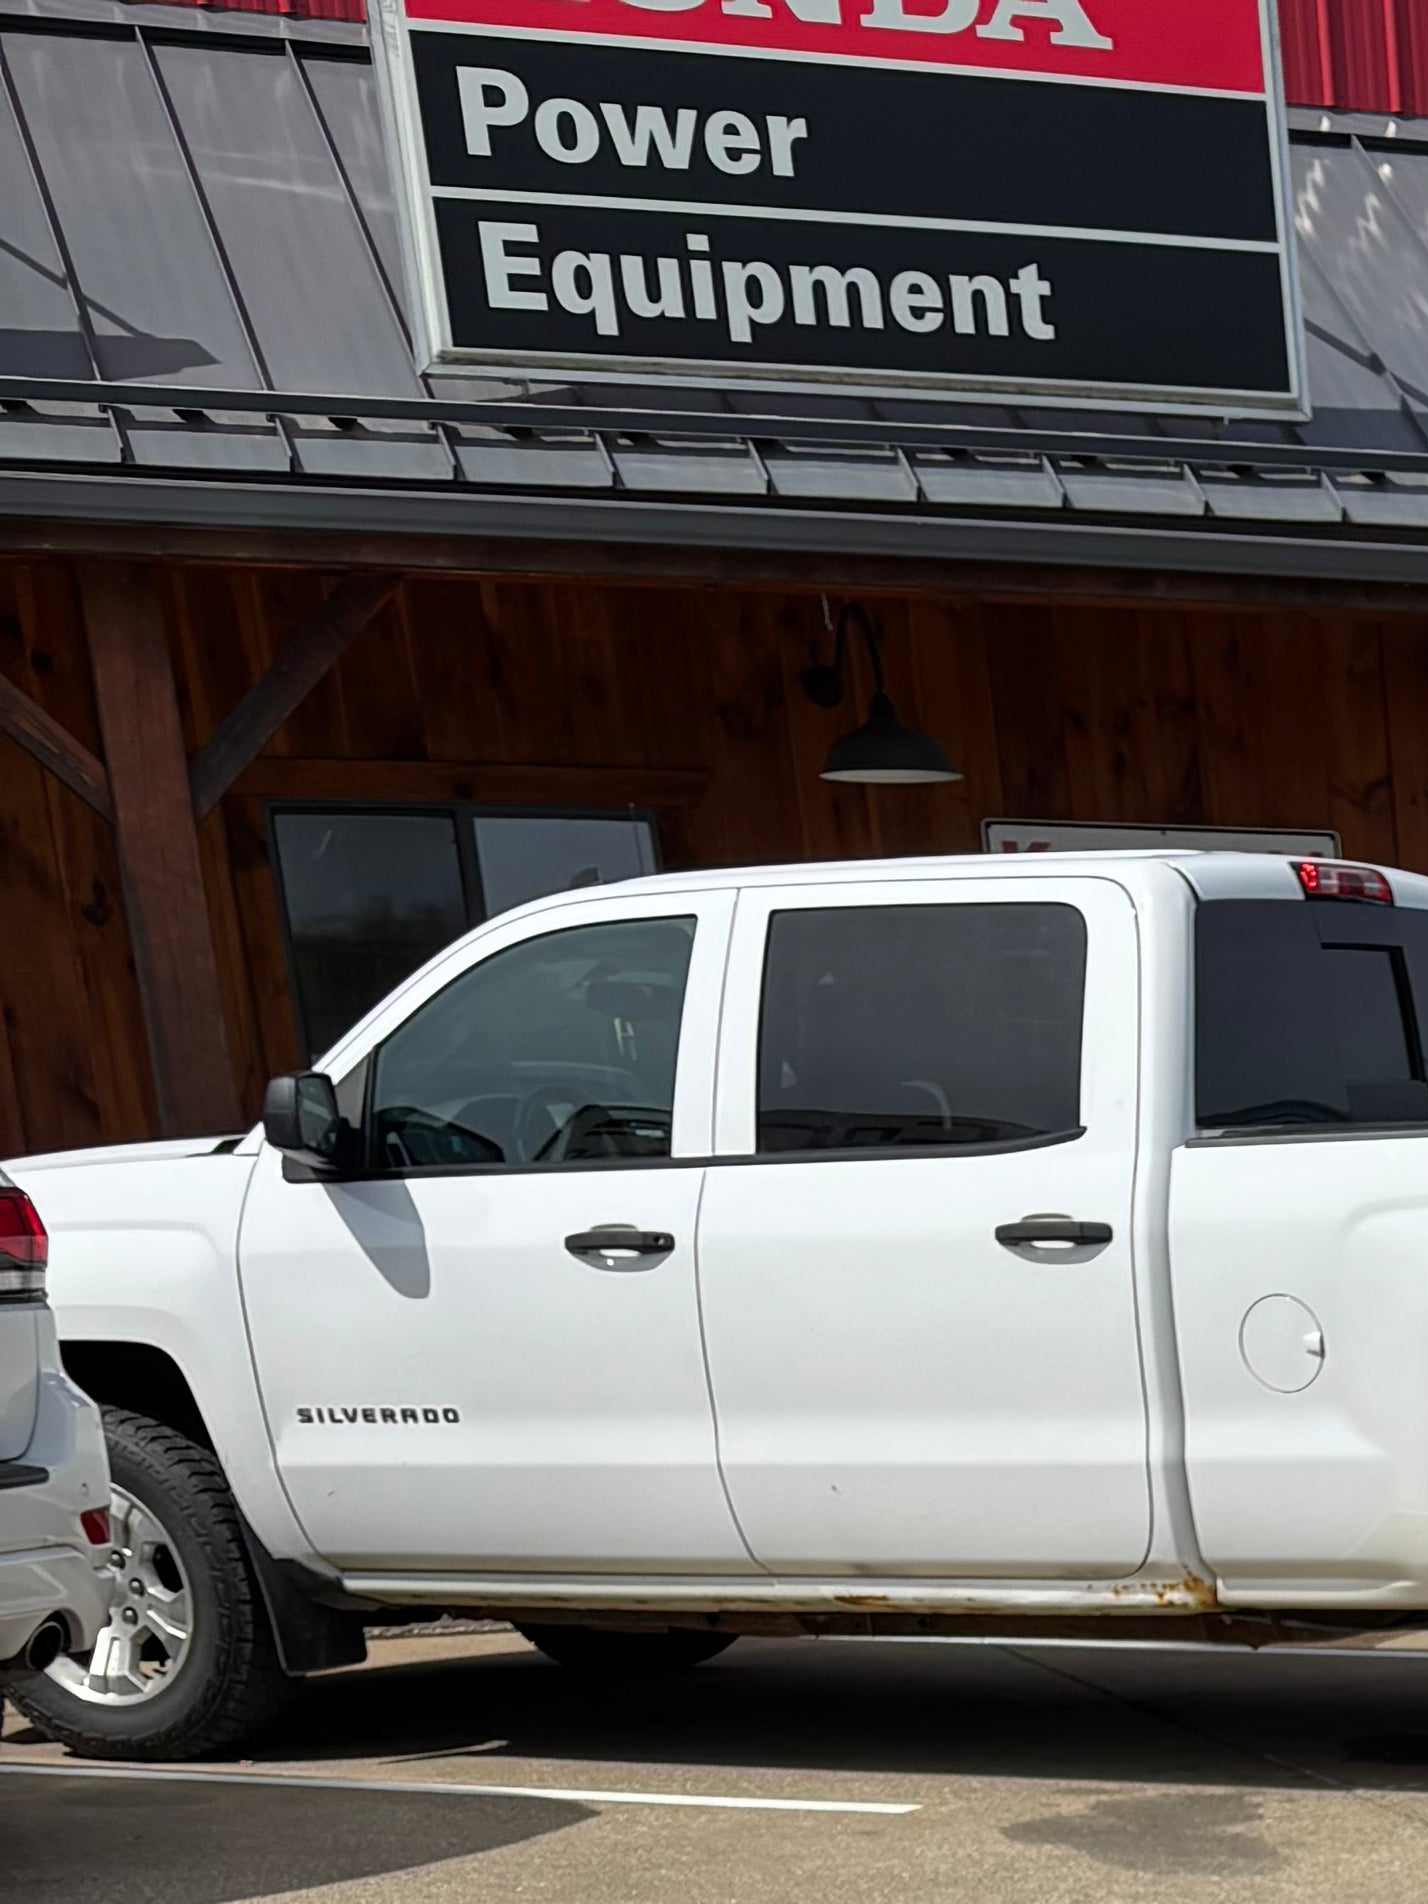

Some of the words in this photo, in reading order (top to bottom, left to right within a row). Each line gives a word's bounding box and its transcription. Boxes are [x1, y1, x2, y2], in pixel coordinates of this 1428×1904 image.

[455, 65, 809, 177] Power
[477, 220, 1056, 343] Equipment
[296, 1406, 461, 1425] SILVERADO
